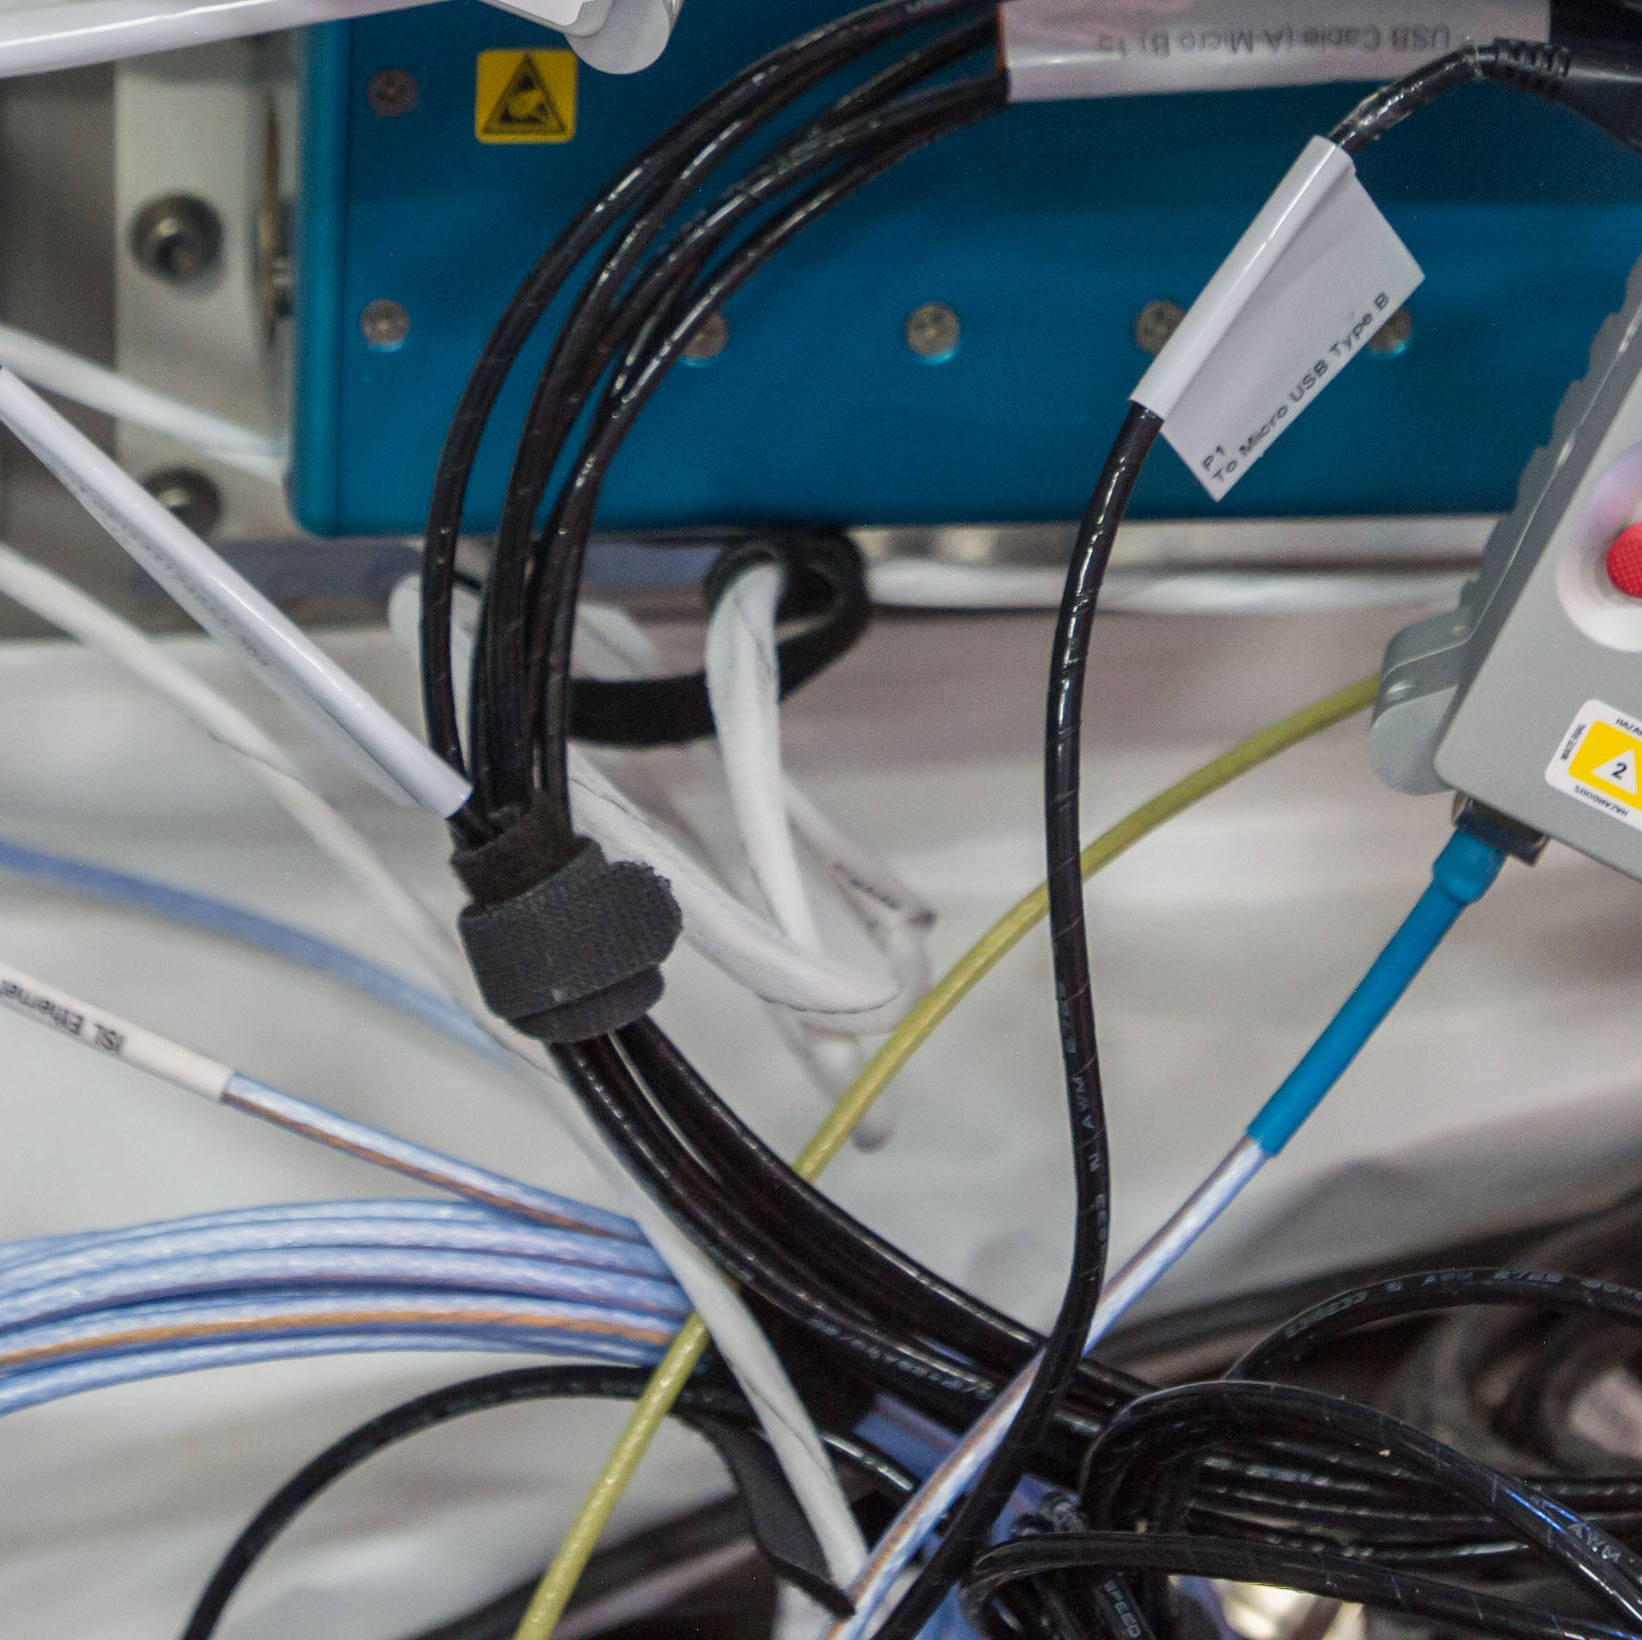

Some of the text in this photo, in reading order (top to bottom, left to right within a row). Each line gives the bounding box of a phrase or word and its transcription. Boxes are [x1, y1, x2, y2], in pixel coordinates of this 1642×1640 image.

[1391, 23, 1453, 52] USB
[1212, 291, 1391, 483] To Micro USB Type B
[1202, 444, 1226, 472] P1
[1610, 762, 1628, 781] 2
